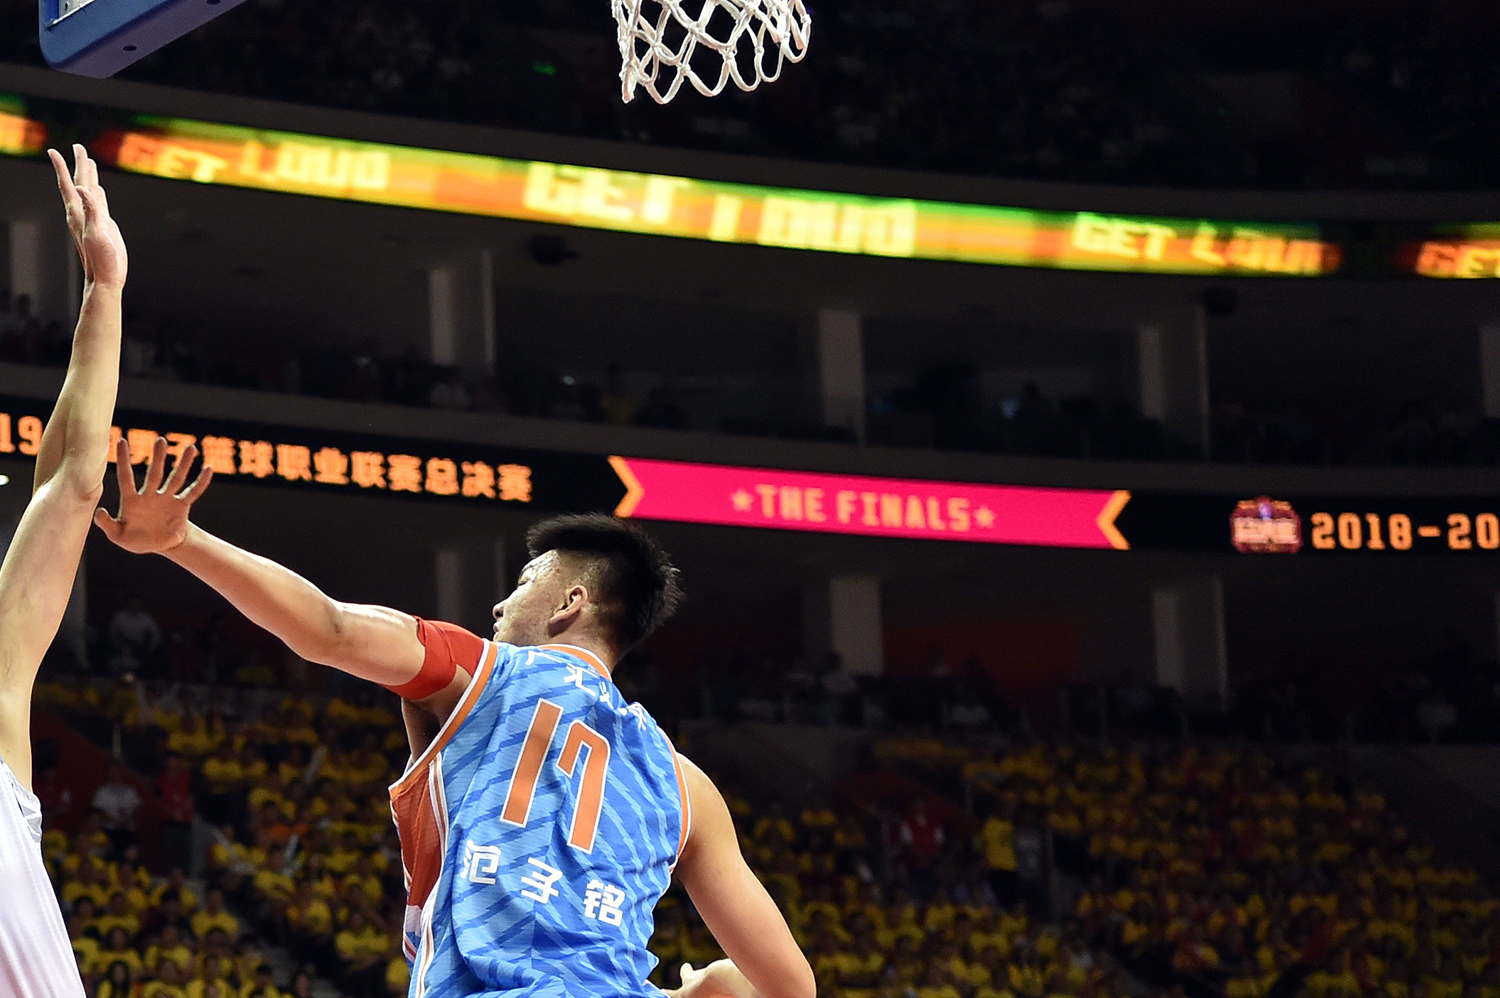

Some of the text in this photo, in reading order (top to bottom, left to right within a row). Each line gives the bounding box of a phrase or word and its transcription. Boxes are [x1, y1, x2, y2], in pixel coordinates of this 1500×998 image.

[755, 483, 972, 533] THE FINALS
[1310, 512, 1500, 550] 2018-20
[501, 697, 612, 856] 17
